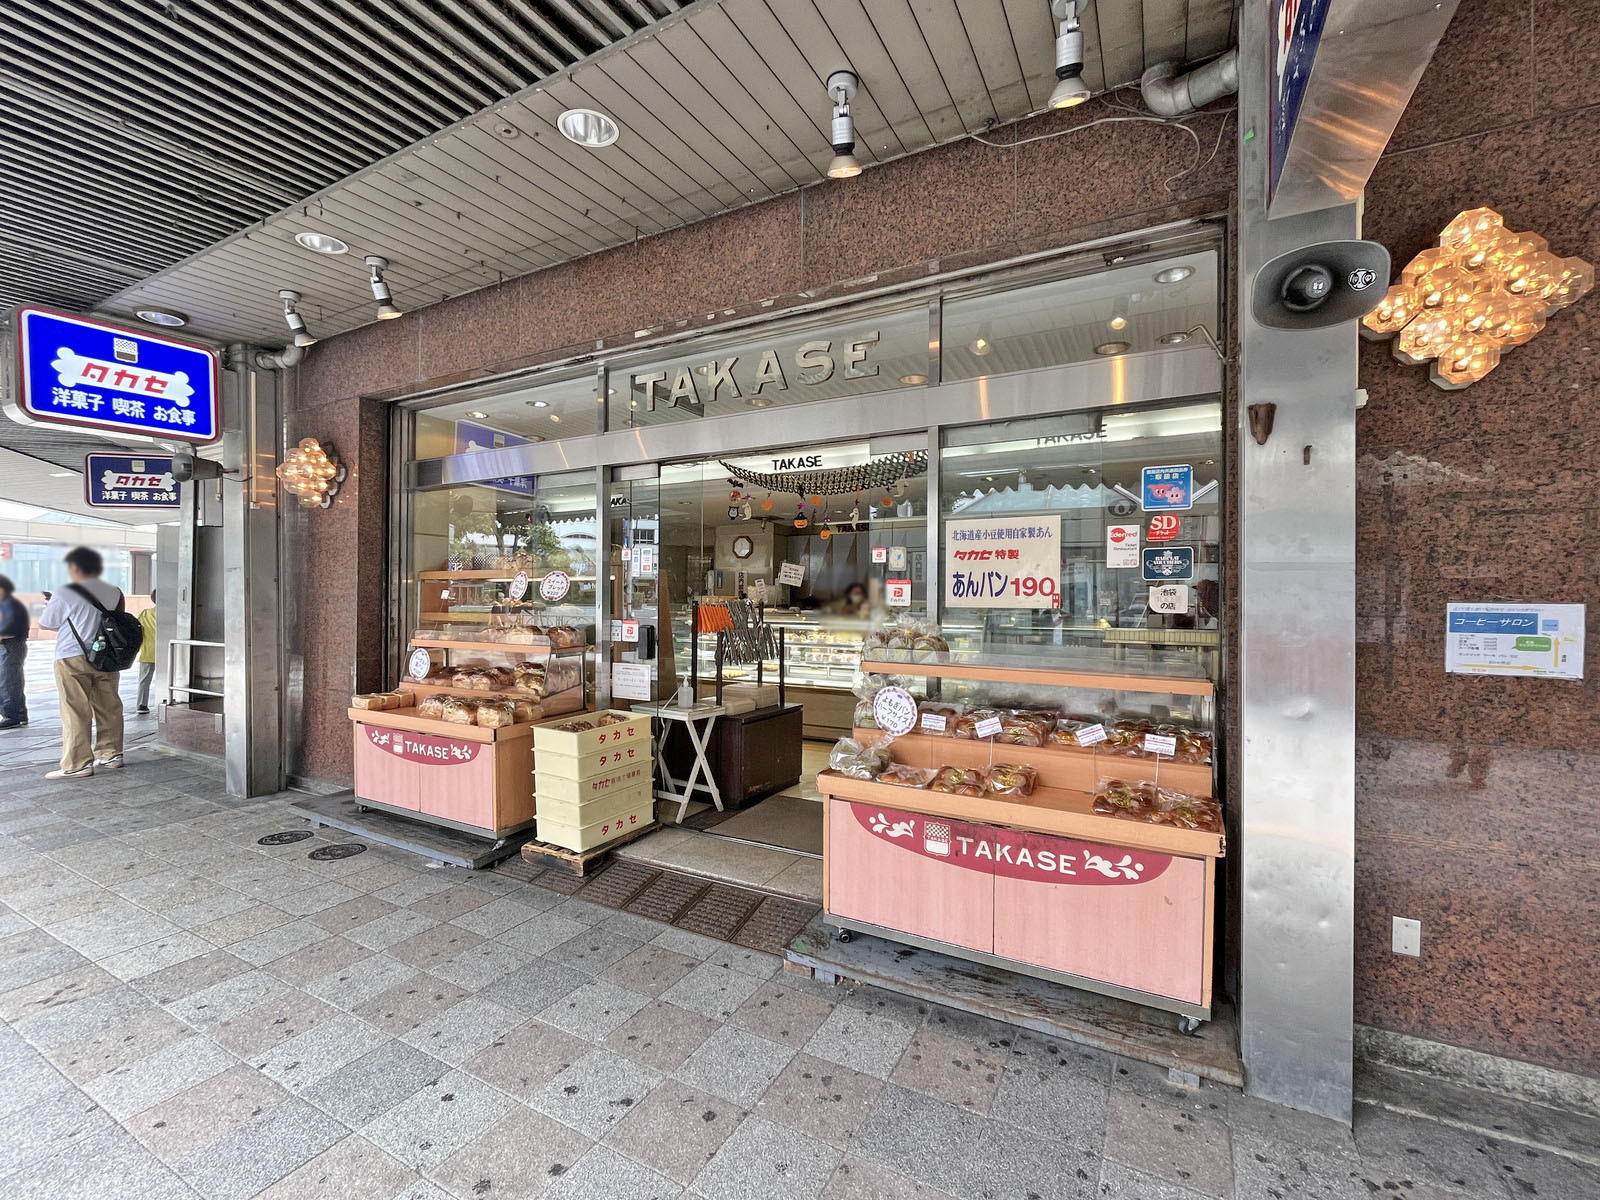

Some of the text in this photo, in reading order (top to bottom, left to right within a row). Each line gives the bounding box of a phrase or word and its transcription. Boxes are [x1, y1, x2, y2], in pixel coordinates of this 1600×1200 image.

[81, 362, 169, 395] タカセ
[634, 331, 880, 411] TAKASE
[52, 386, 196, 426] 洋菓子 喫茶 お食事
[771, 455, 823, 471] TAKASE
[115, 475, 162, 487] タカセ
[101, 490, 128, 501] 洋菓子
[152, 492, 177, 502] お食事
[1149, 515, 1177, 530] SD
[952, 526, 1053, 541] 北海道産小豆使用自家製あん
[953, 549, 1020, 561] タカセ 特製
[878, 702, 909, 725] ハーフサイズ
[882, 695, 911, 716] よもぎパン
[598, 726, 635, 745] タカセ
[404, 740, 450, 760] TAKASE
[599, 748, 635, 767] タカセ
[601, 814, 637, 836] タカセ
[955, 835, 1077, 876] TAKASE
